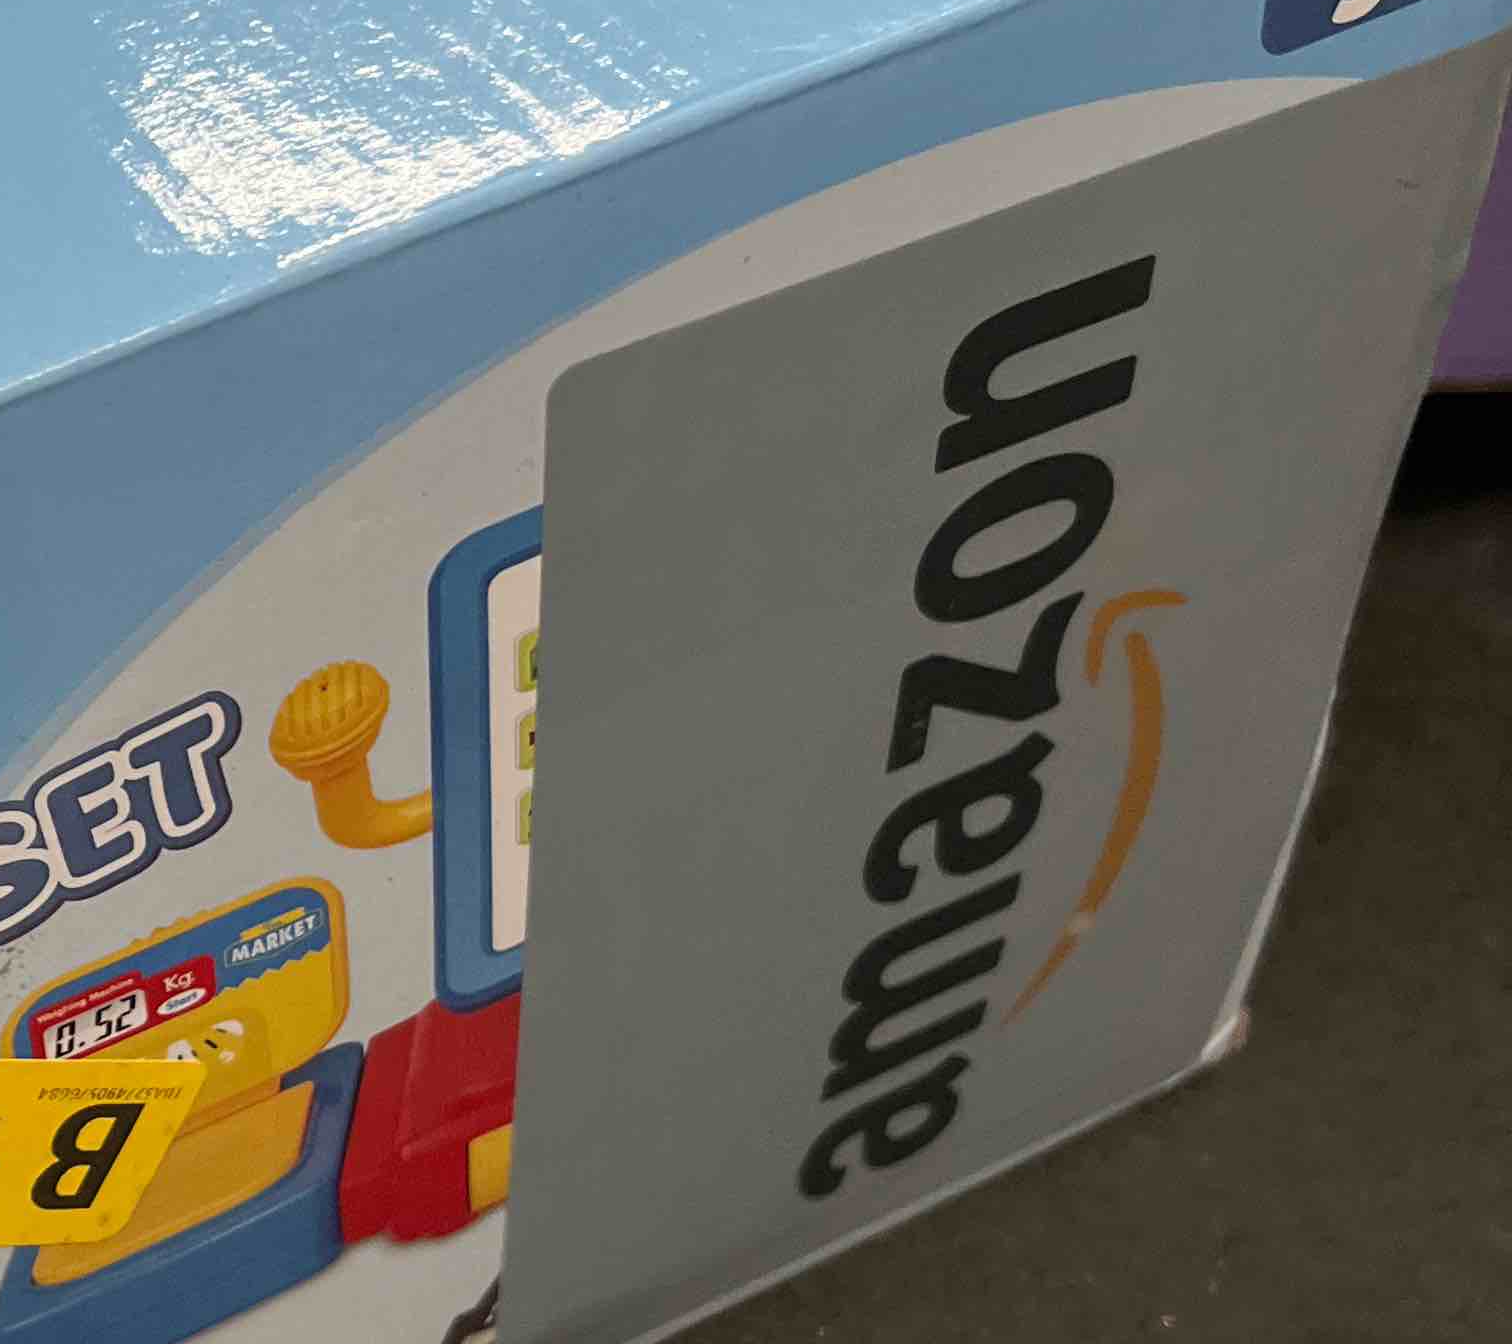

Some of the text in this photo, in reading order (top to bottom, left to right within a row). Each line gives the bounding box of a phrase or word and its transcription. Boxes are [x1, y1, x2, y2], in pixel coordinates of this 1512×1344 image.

[797, 253, 1157, 1204] amazon
[231, 913, 318, 964] MARKET
[30, 1103, 146, 1209] B
